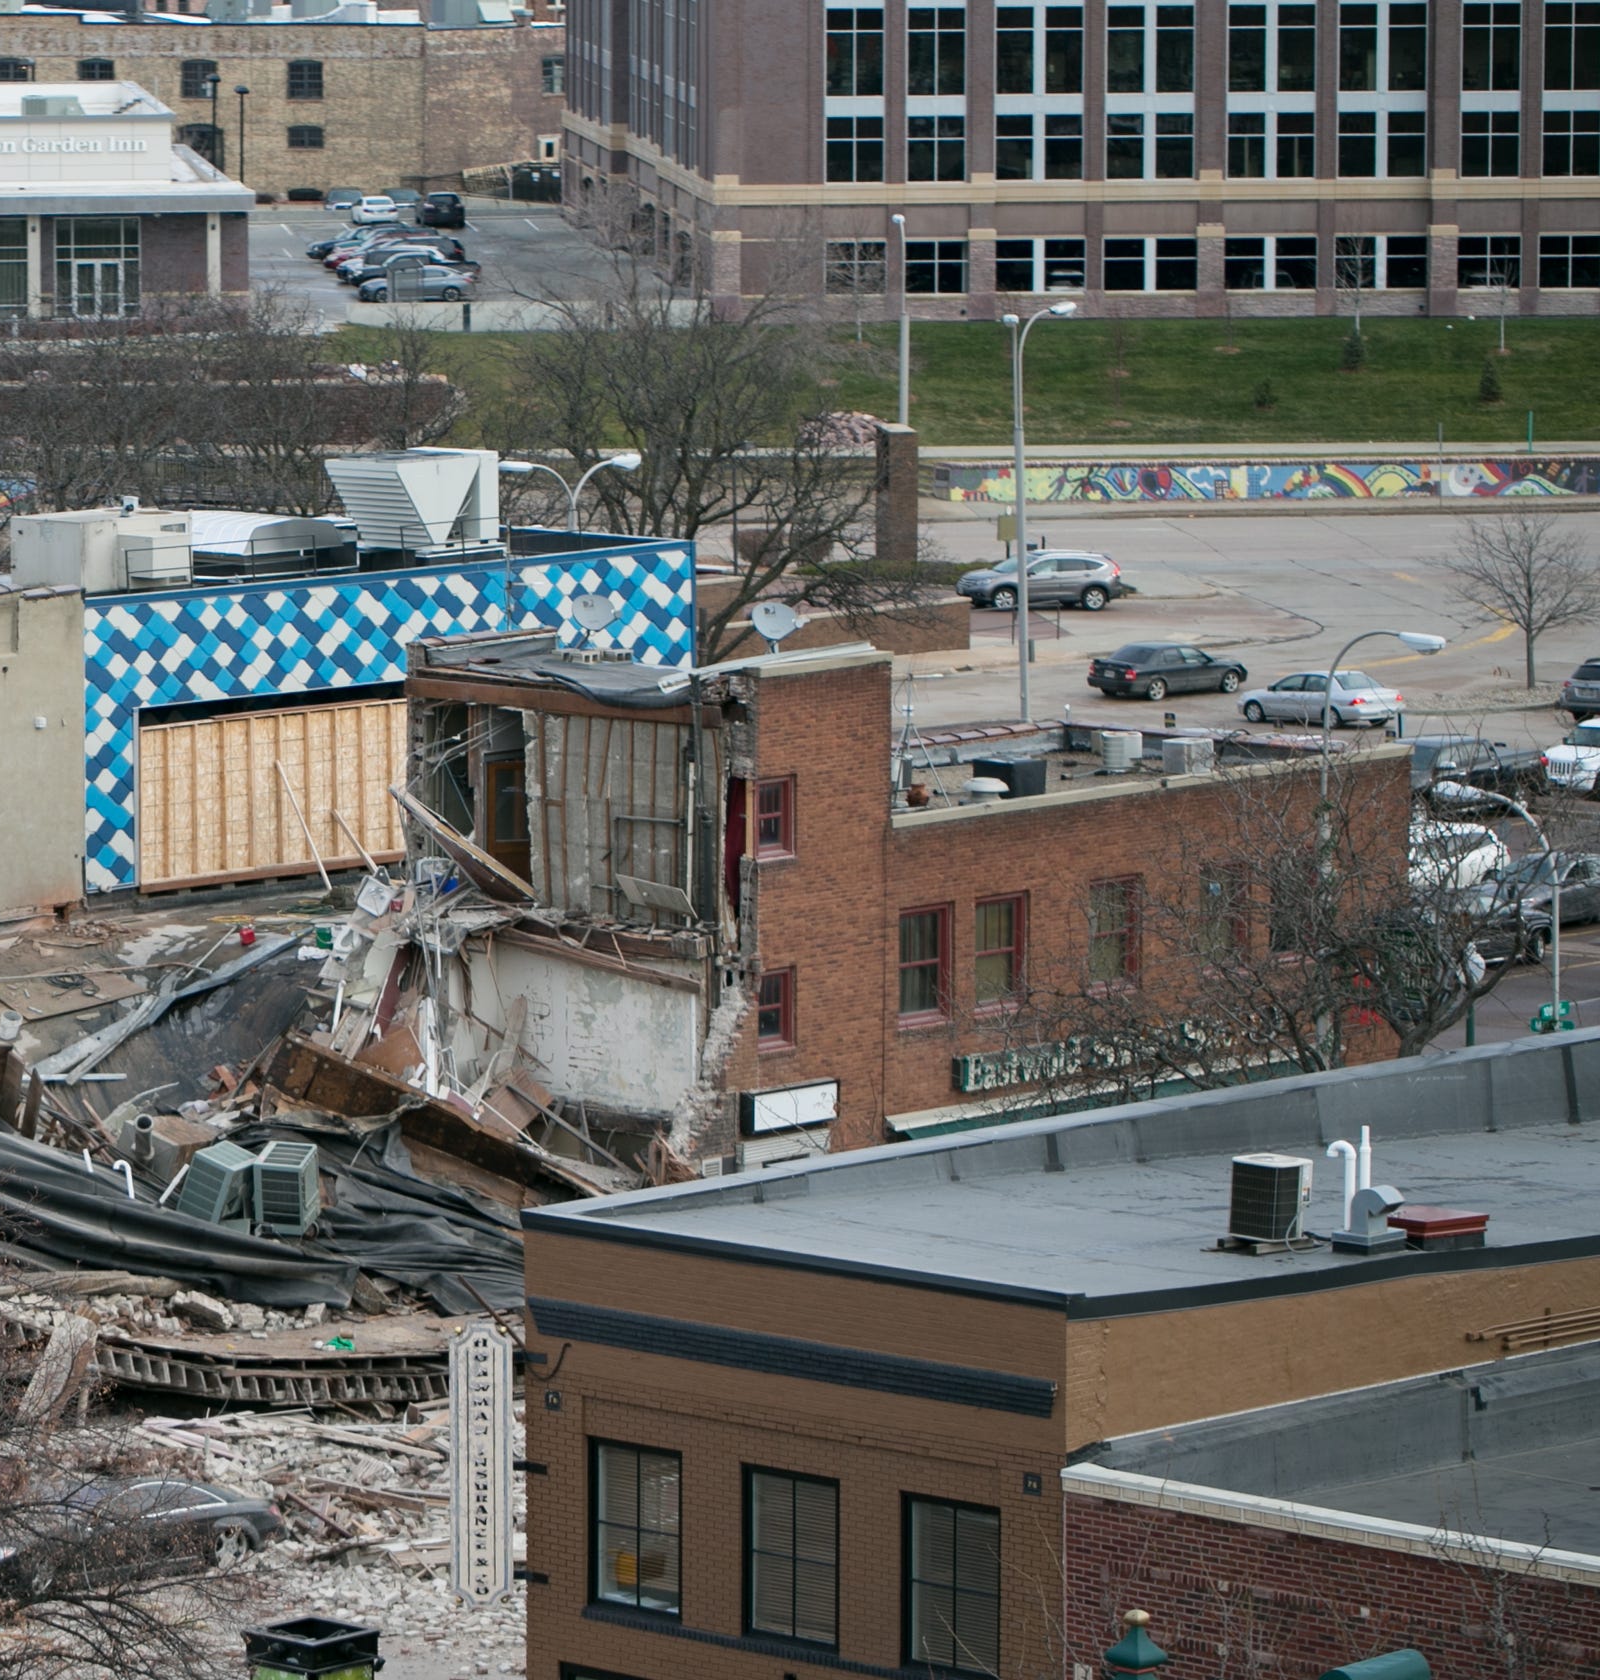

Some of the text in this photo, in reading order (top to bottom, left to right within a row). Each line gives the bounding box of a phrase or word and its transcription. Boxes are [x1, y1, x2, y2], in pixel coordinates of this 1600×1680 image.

[22, 136, 103, 154] Garden
[107, 135, 147, 153] Inn
[474, 1444, 489, 1551] INSURANCE
